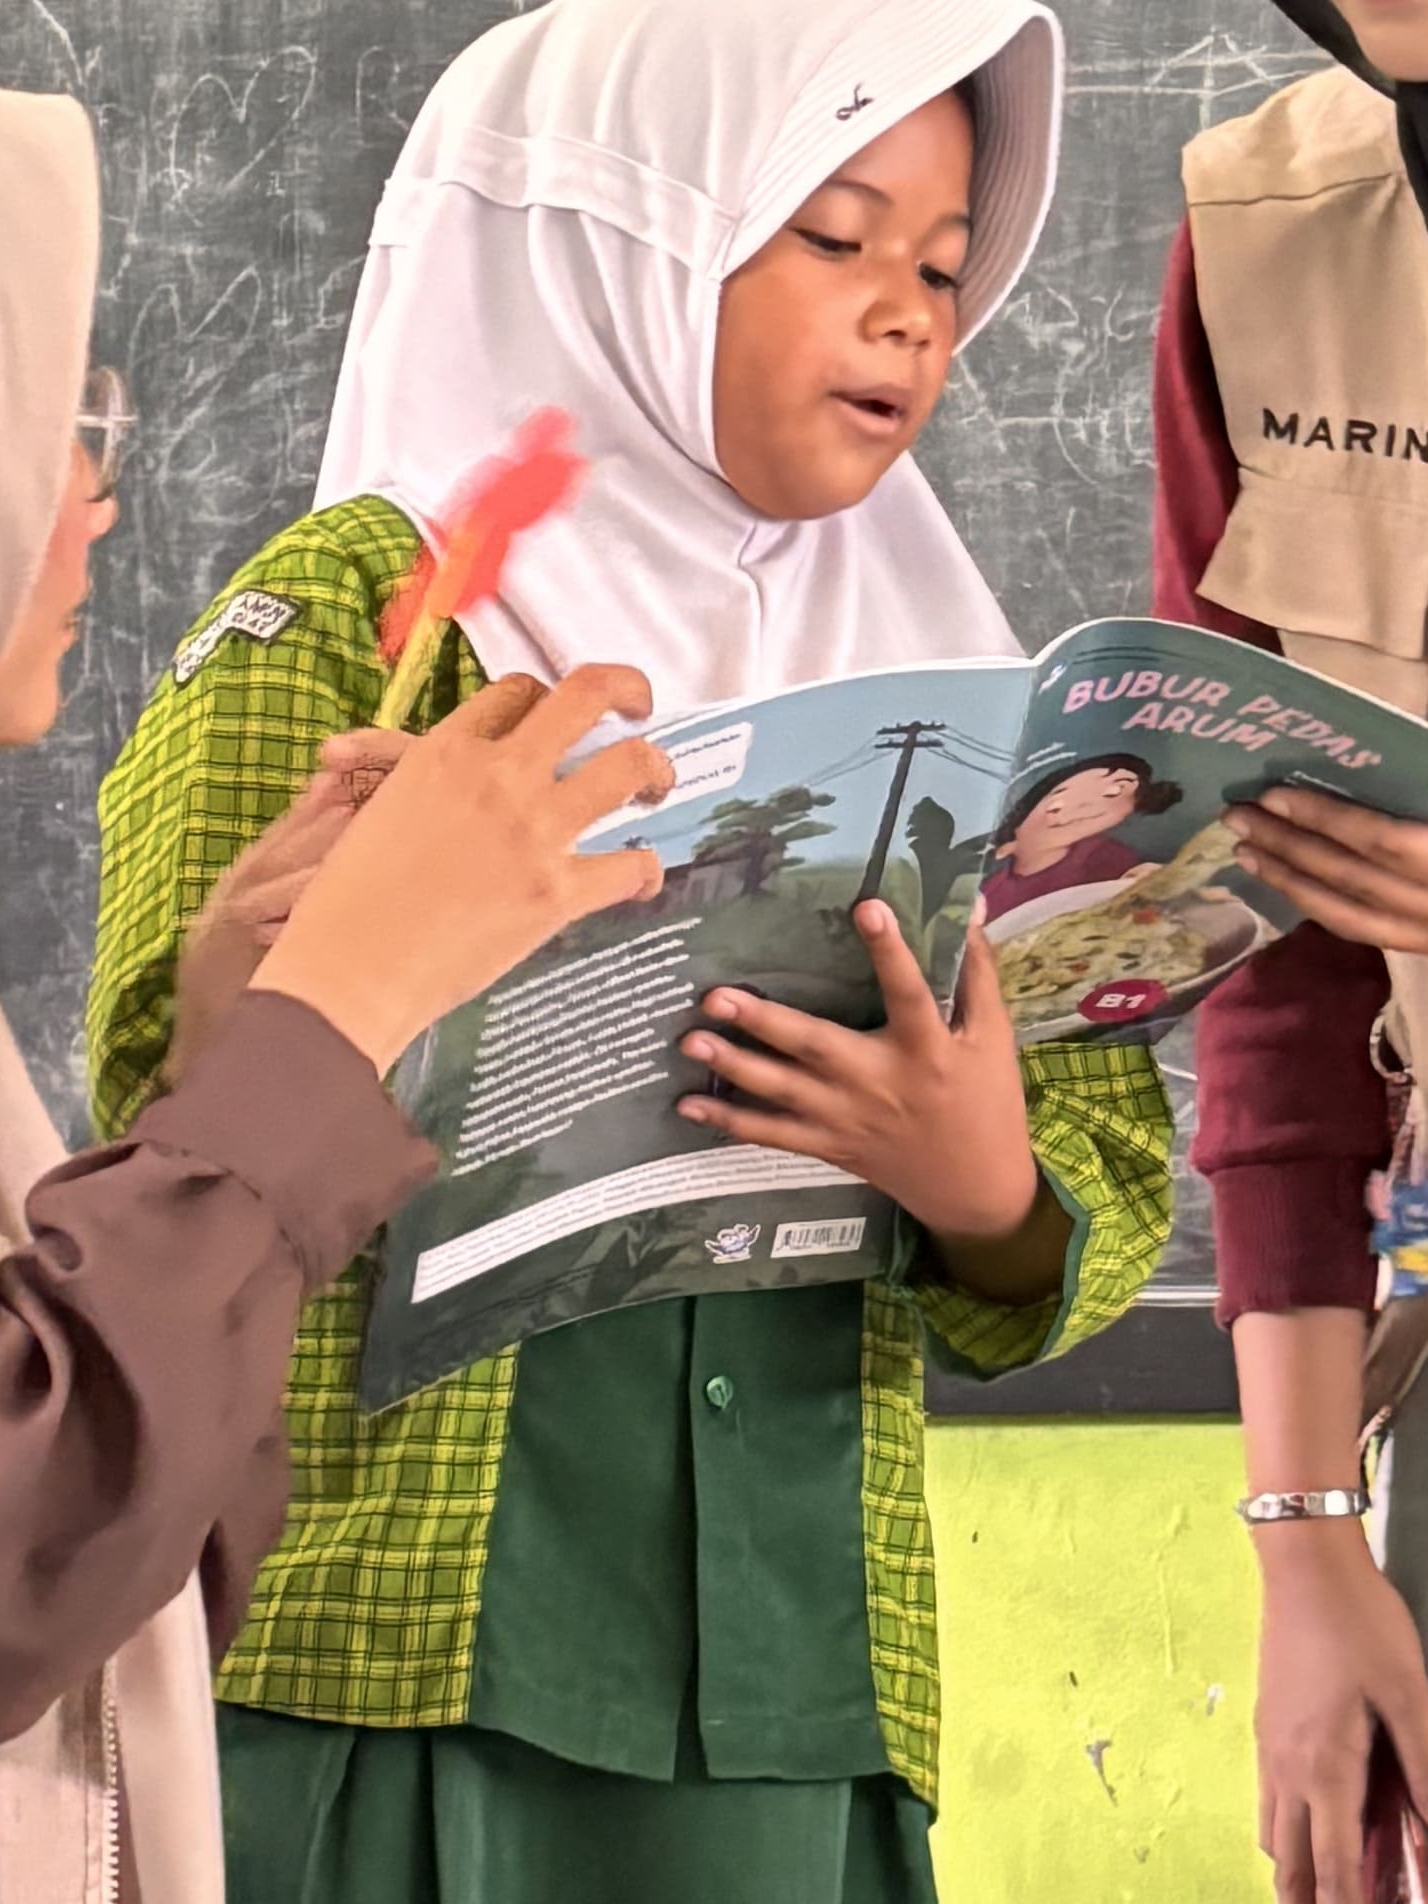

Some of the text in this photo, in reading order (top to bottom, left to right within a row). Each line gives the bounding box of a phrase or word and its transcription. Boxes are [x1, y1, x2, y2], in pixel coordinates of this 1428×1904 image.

[1063, 670, 1383, 769] BUBUR PEDAS
[1122, 701, 1277, 752] ARUM
[1095, 993, 1147, 1009] B1
